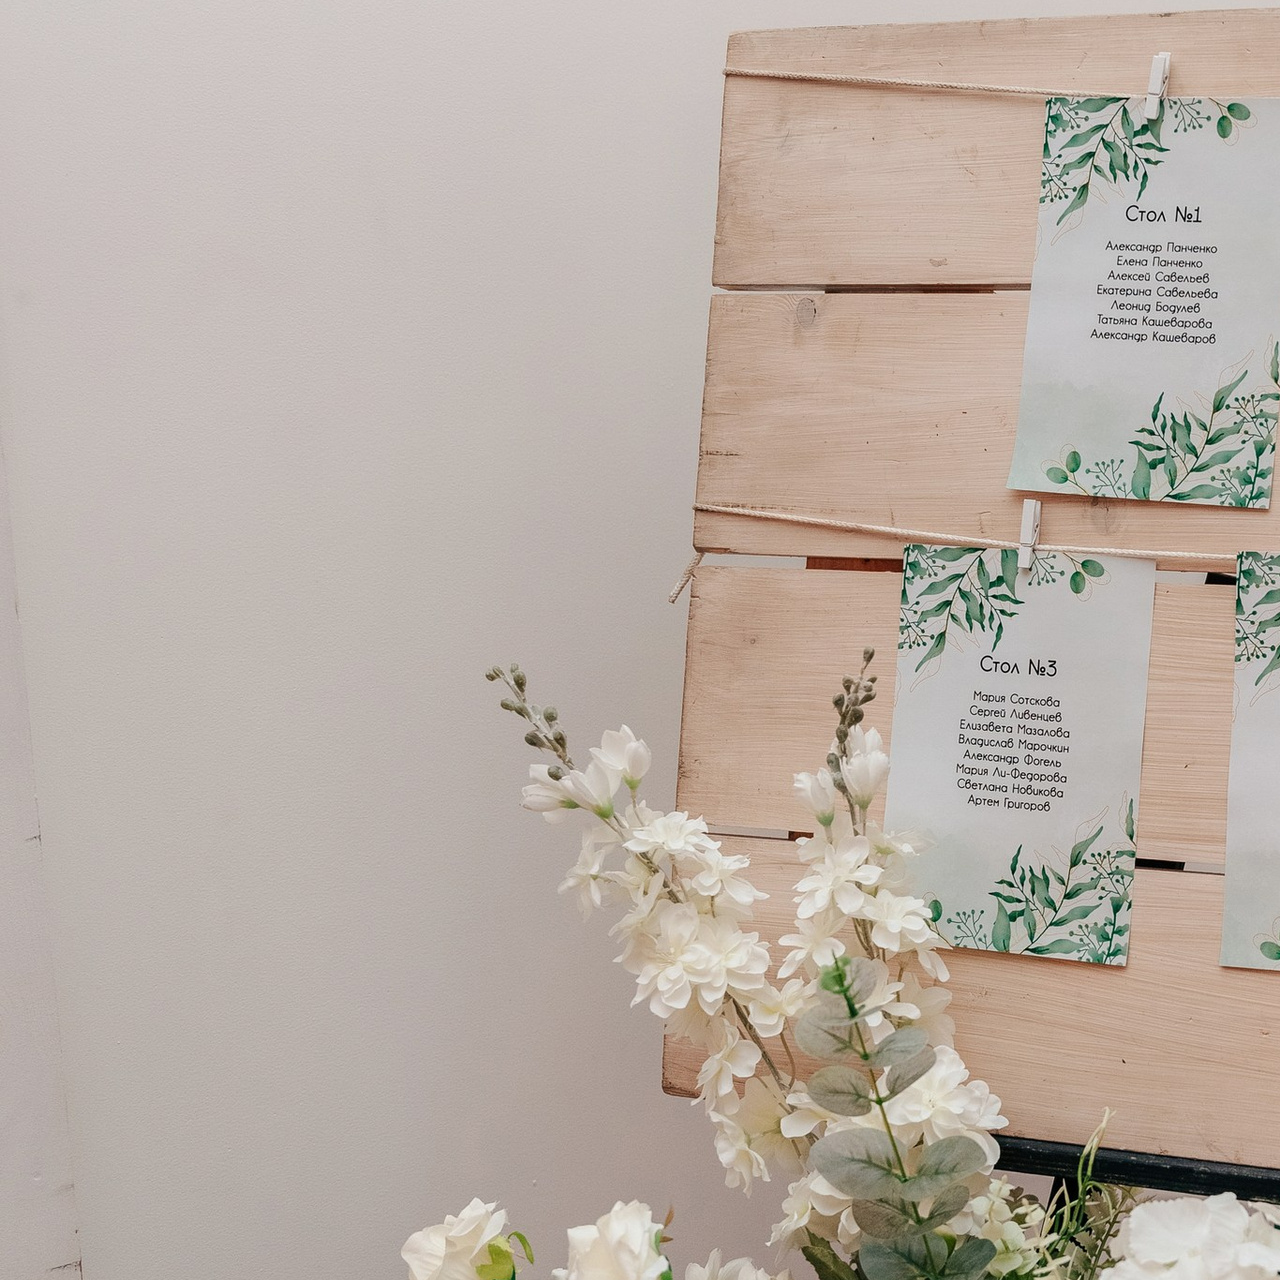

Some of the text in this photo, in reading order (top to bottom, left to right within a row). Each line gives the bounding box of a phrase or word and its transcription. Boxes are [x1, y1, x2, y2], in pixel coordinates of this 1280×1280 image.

[1126, 205, 1202, 223] Стол №1
[1105, 241, 1217, 254] Александр Панченко
[1117, 256, 1203, 268] Елена Панченко
[1107, 270, 1209, 283] Алексей Савельев
[1097, 285, 1218, 299] Екатерина Савельева
[1111, 300, 1200, 314] Леонид Бодулев
[1097, 314, 1212, 329] Татьяна Кашеварова
[1090, 329, 1216, 344] Александр Кашеваров
[980, 655, 1057, 677] Стол №3
[973, 691, 1060, 707] Мария Сотскова
[970, 705, 1062, 722] Сергей Ливенцев
[960, 719, 1070, 738] Елизавета Мазалова
[958, 734, 1069, 753] Владислав Марочкин
[962, 750, 1061, 767] Александр Фогель
[956, 764, 1067, 783] Мария Ли-Федорова
[957, 778, 1063, 798] Светлана Новикова
[968, 795, 1050, 812] Артем Григоров
